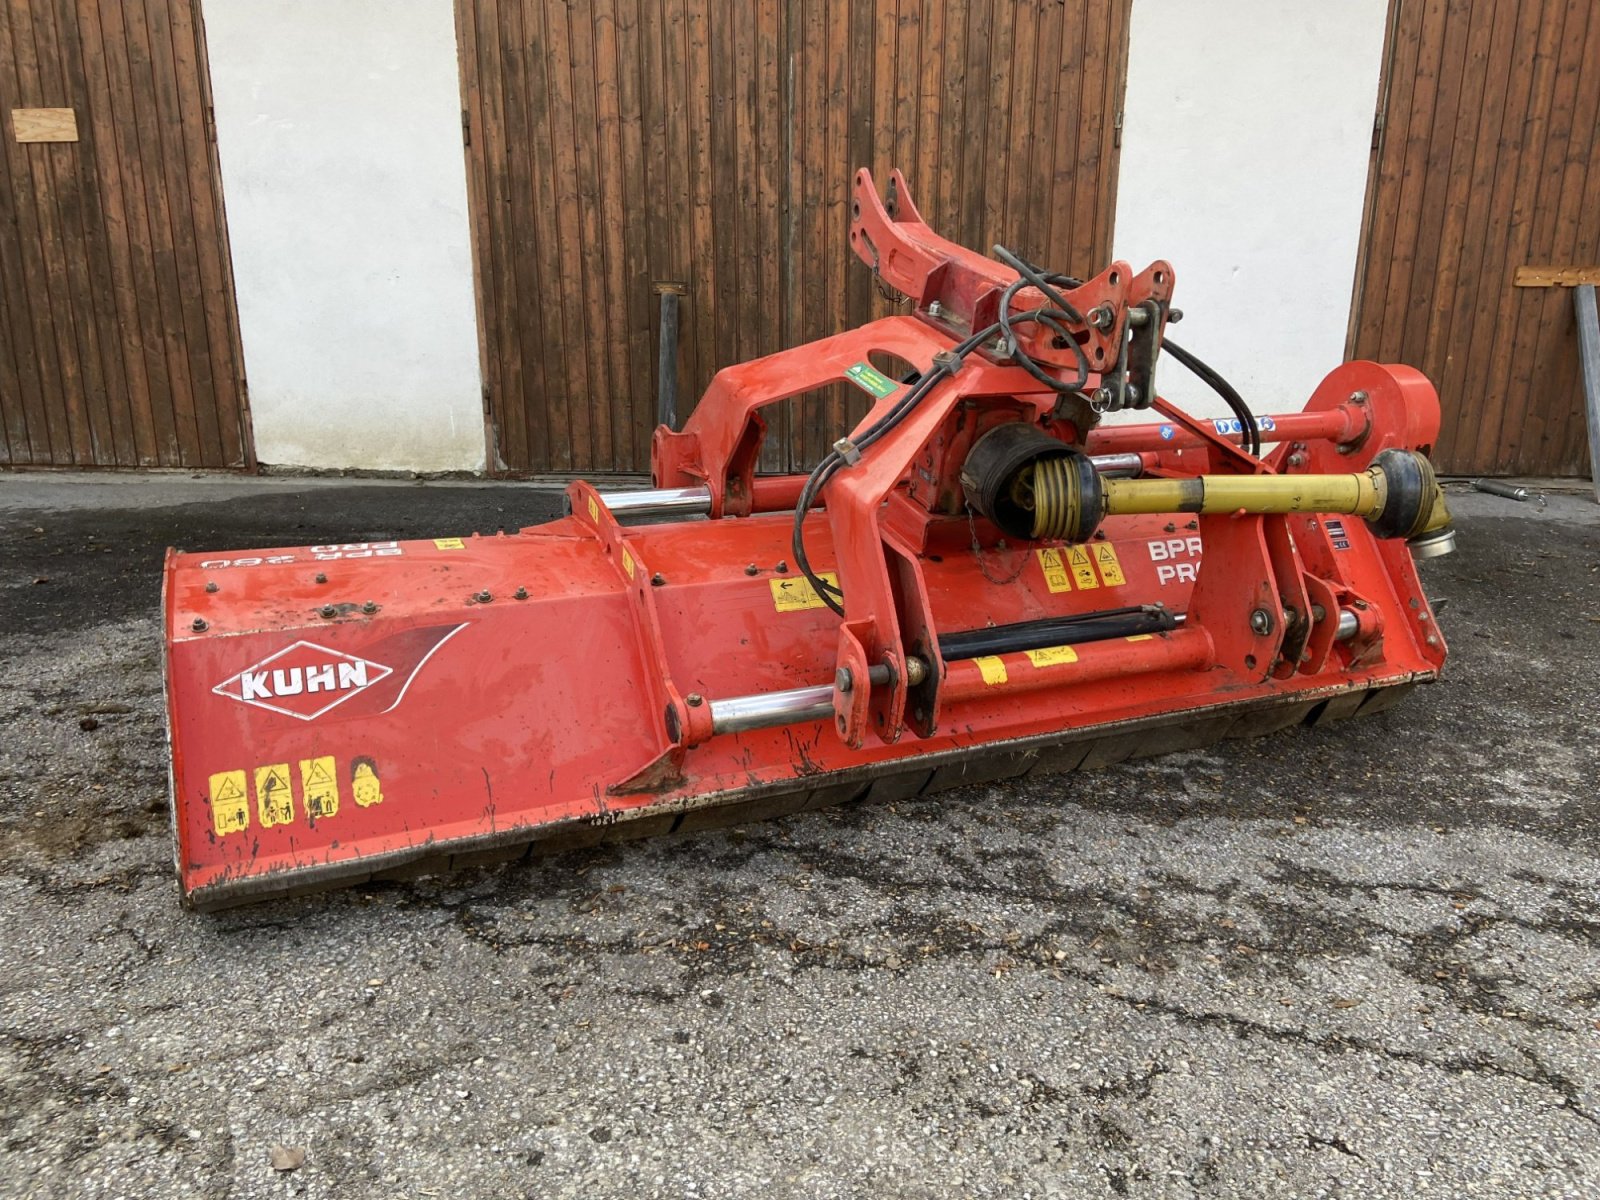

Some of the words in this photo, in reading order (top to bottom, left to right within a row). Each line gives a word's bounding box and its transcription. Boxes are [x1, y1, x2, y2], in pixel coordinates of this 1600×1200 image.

[310, 541, 398, 553] PRO
[1148, 537, 1202, 560] BPR
[1157, 561, 1201, 585] PR
[241, 660, 368, 700] KUHN
